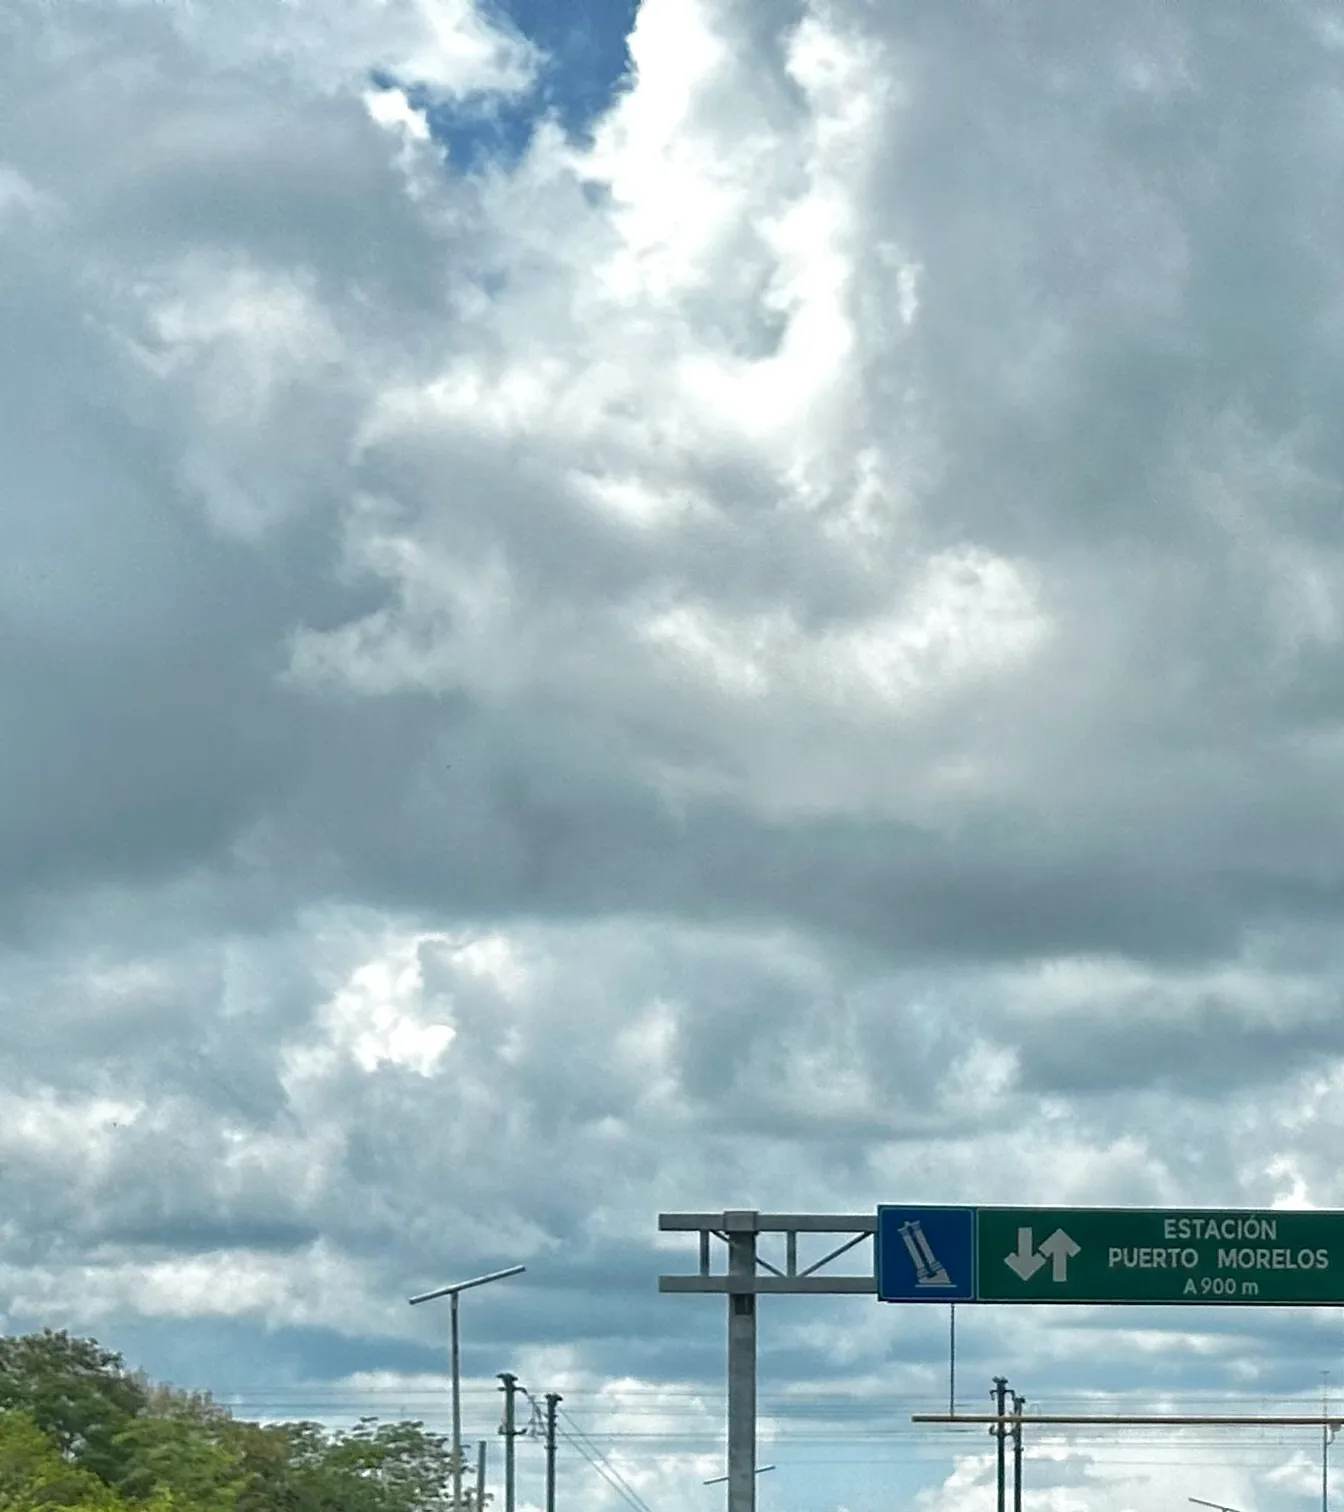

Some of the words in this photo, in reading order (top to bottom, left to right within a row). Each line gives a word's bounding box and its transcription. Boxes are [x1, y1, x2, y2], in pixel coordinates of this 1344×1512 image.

[1164, 1216, 1277, 1240] ESTACIÓN
[1108, 1247, 1199, 1268] PUERTO
[1217, 1248, 1329, 1269] MORELOS
[1201, 1277, 1237, 1295] 900
[1242, 1281, 1259, 1295] m
